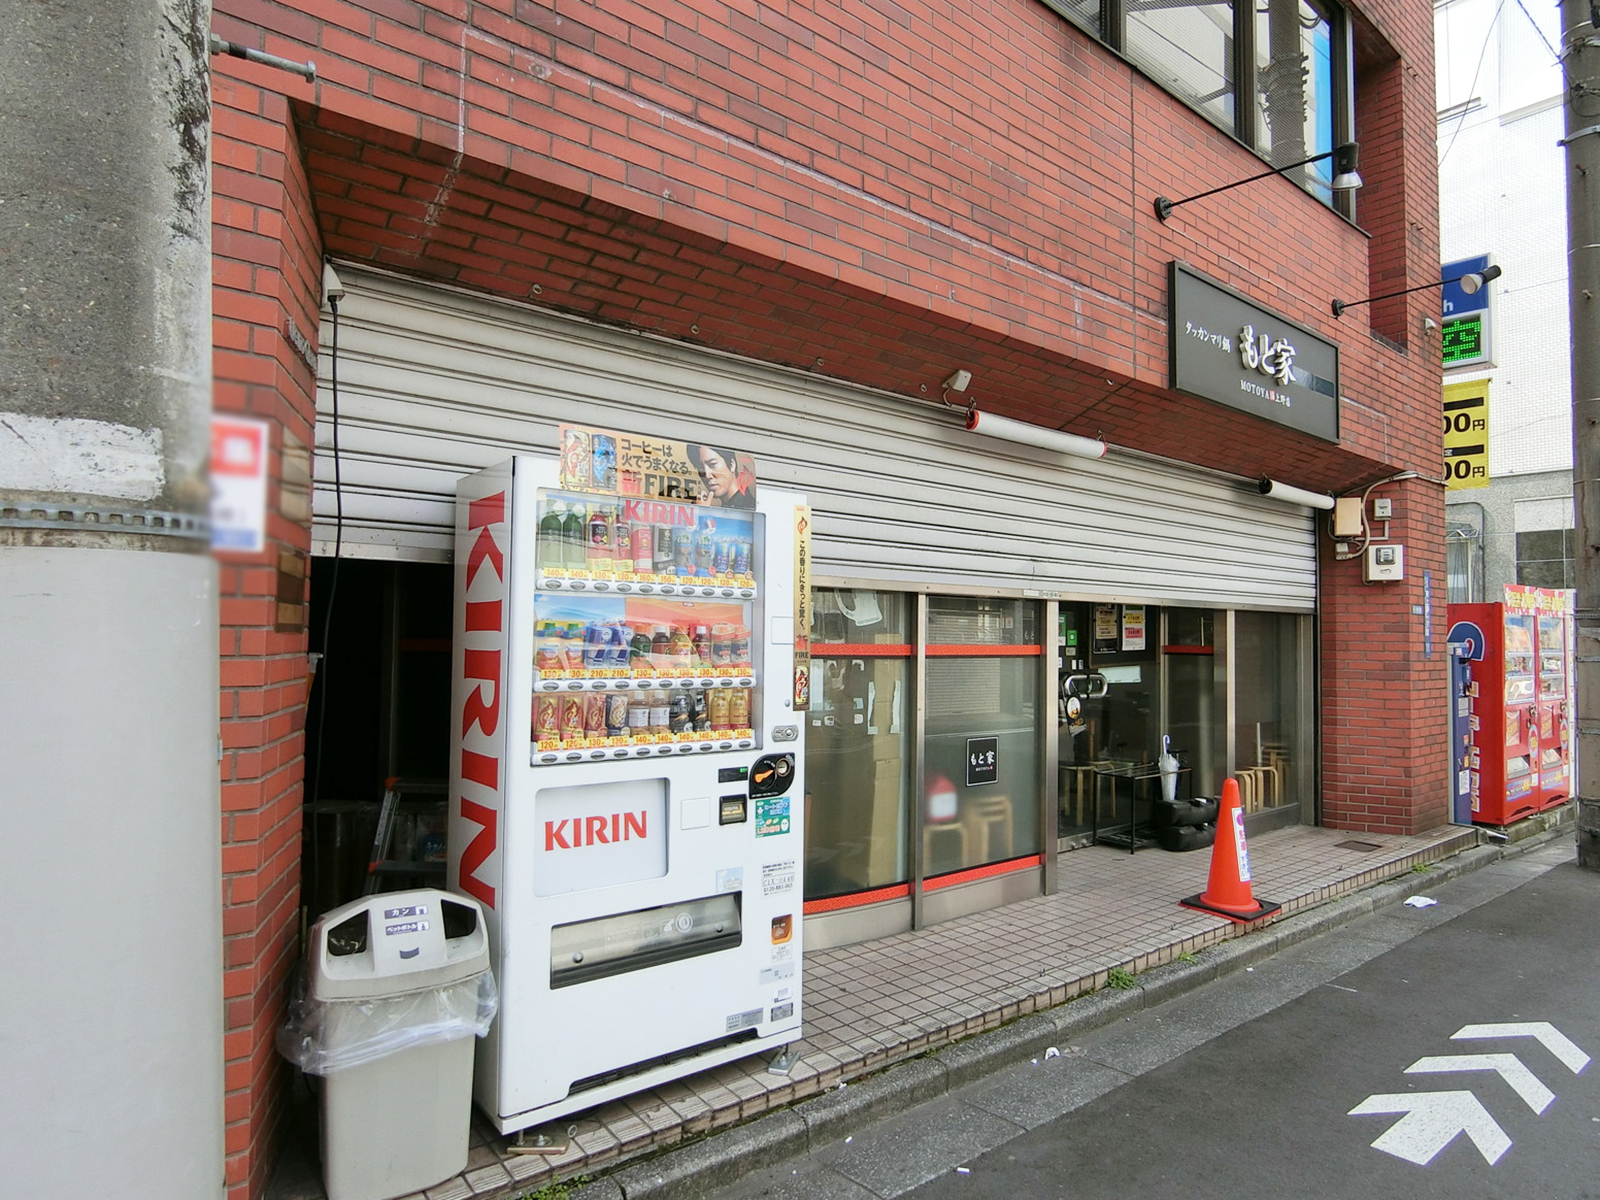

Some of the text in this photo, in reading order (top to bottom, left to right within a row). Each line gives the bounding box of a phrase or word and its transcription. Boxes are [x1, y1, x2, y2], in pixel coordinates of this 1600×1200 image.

[1185, 321, 1231, 353] タッカンマリ鍋
[1442, 320, 1481, 363] 空
[1238, 325, 1297, 387] もと家
[1240, 379, 1270, 400] MOTOYA
[621, 438, 673, 457] コーヒーは
[622, 453, 692, 475] 火でうまくなる。
[644, 473, 697, 500] FIRE
[624, 500, 695, 527] KIRIN
[795, 651, 809, 659] FIRE
[459, 490, 505, 912] KIRIN
[970, 750, 995, 766] もと家
[544, 810, 647, 852] KIRIN
[392, 908, 410, 916] カン
[387, 923, 417, 933] ペットボトル
